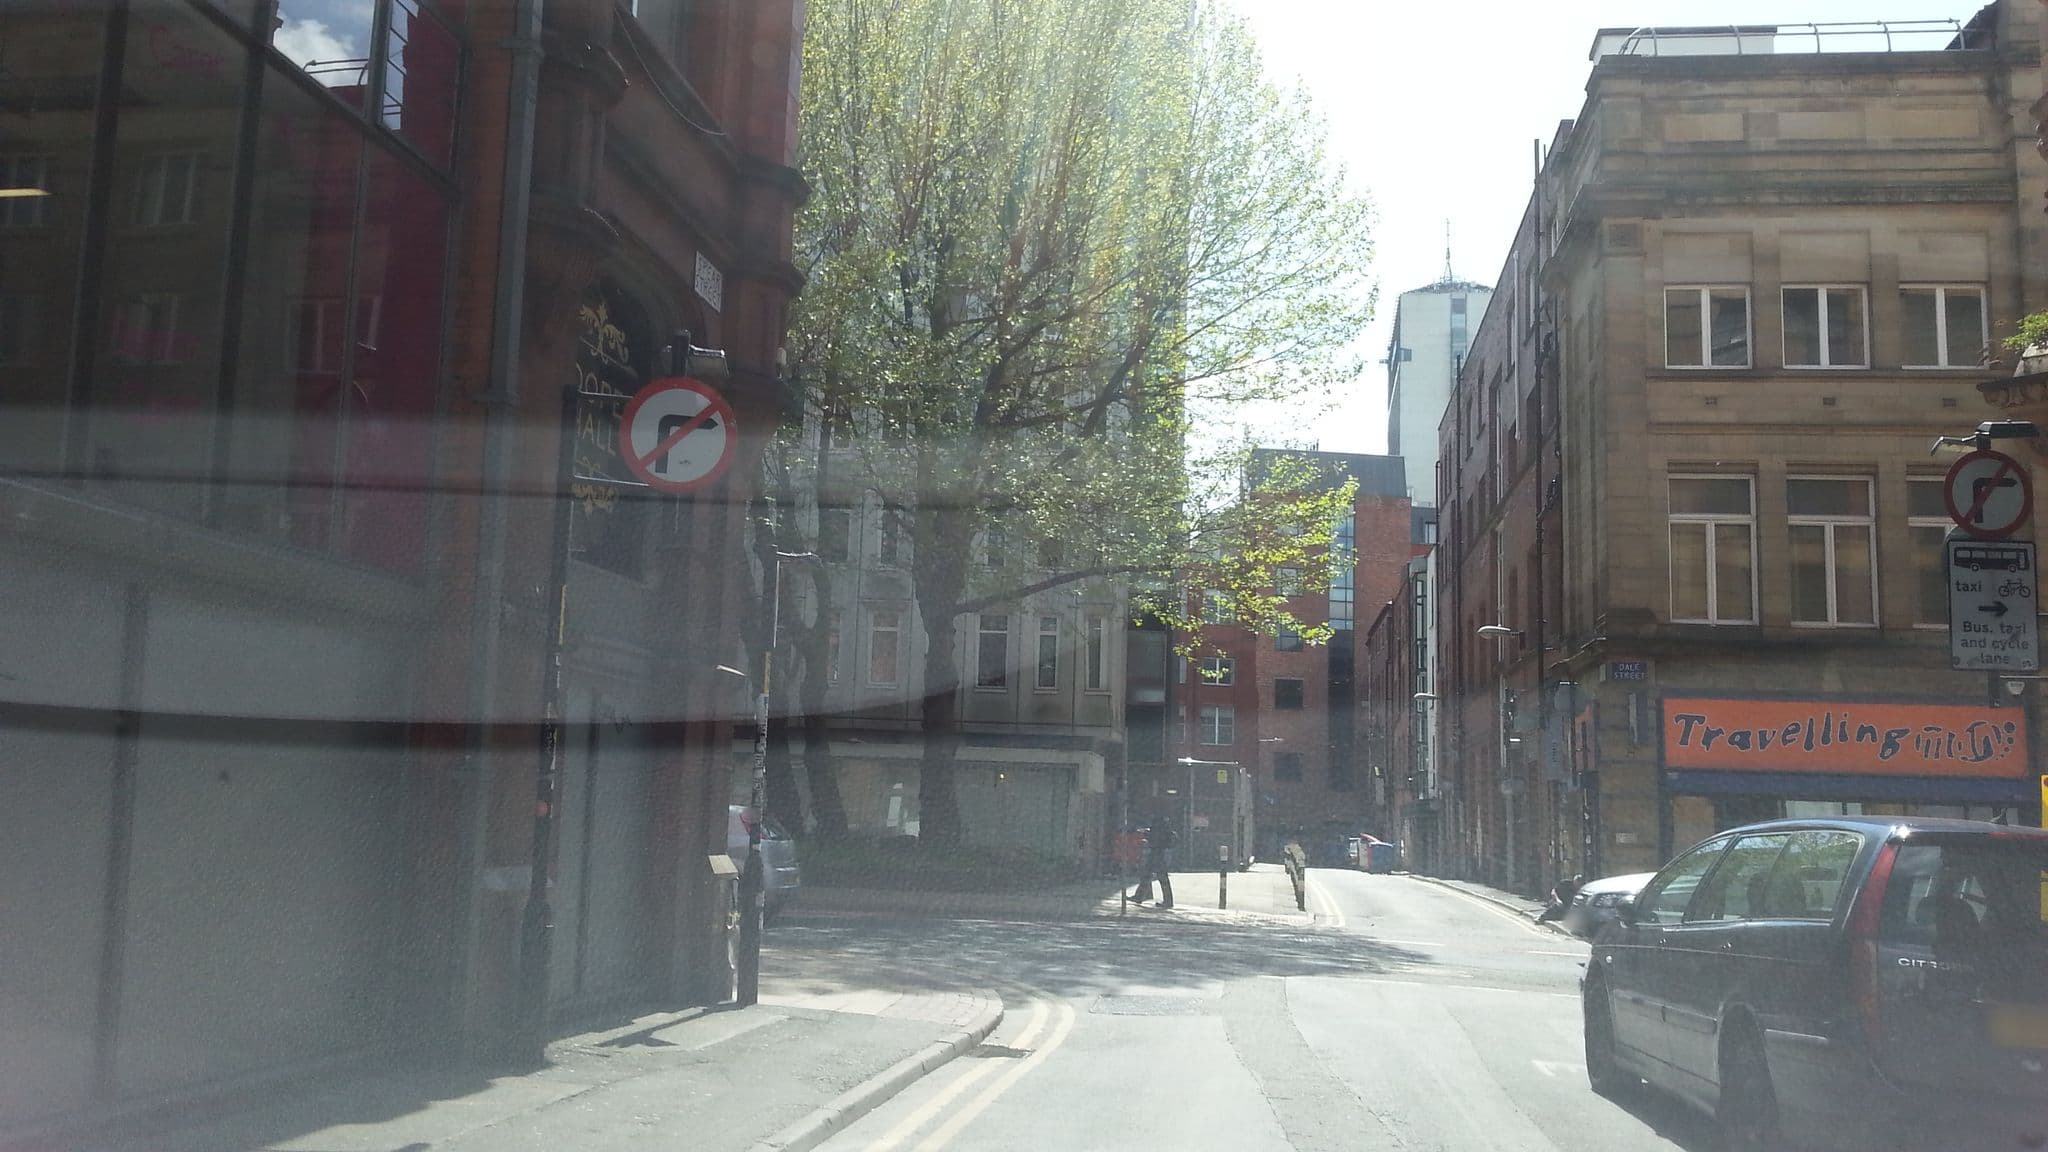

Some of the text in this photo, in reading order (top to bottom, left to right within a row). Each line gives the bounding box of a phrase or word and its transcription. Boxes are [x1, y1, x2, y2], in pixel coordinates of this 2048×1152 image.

[1955, 581, 1982, 592] taxi
[1960, 638, 2029, 651] and cycle
[1980, 653, 2009, 665] lane
[1619, 663, 1641, 672] DALE
[1614, 671, 1648, 680] STREET
[1674, 711, 1911, 760] Travelling
